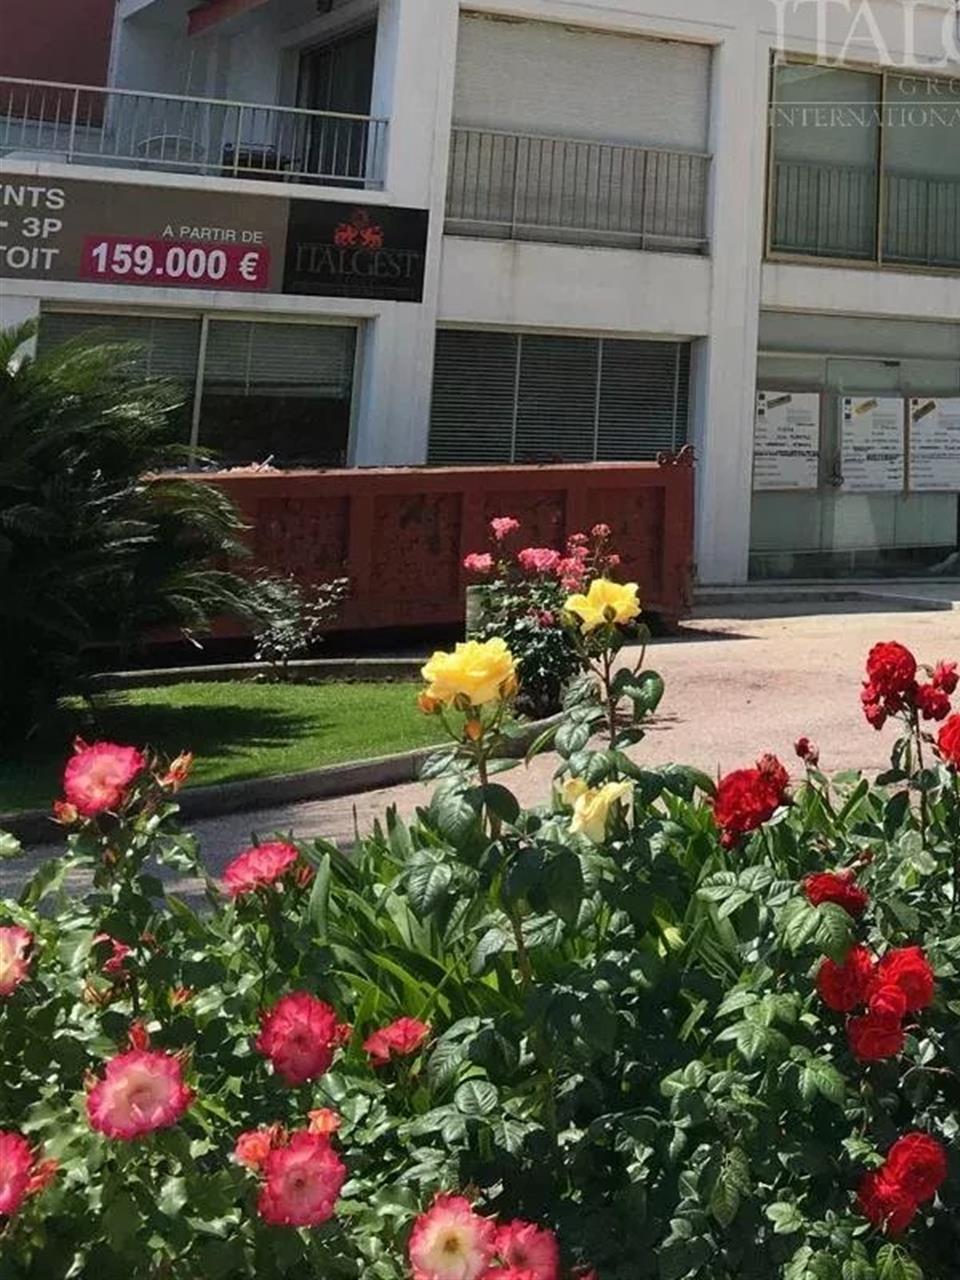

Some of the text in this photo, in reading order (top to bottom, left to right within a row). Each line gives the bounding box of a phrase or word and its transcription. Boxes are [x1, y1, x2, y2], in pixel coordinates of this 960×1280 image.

[0, 184, 65, 209] NTS
[22, 217, 62, 238] 3P
[162, 224, 263, 244] A PARTIR DE
[92, 242, 259, 280] 159.000 €
[296, 243, 419, 277] ITALGEST
